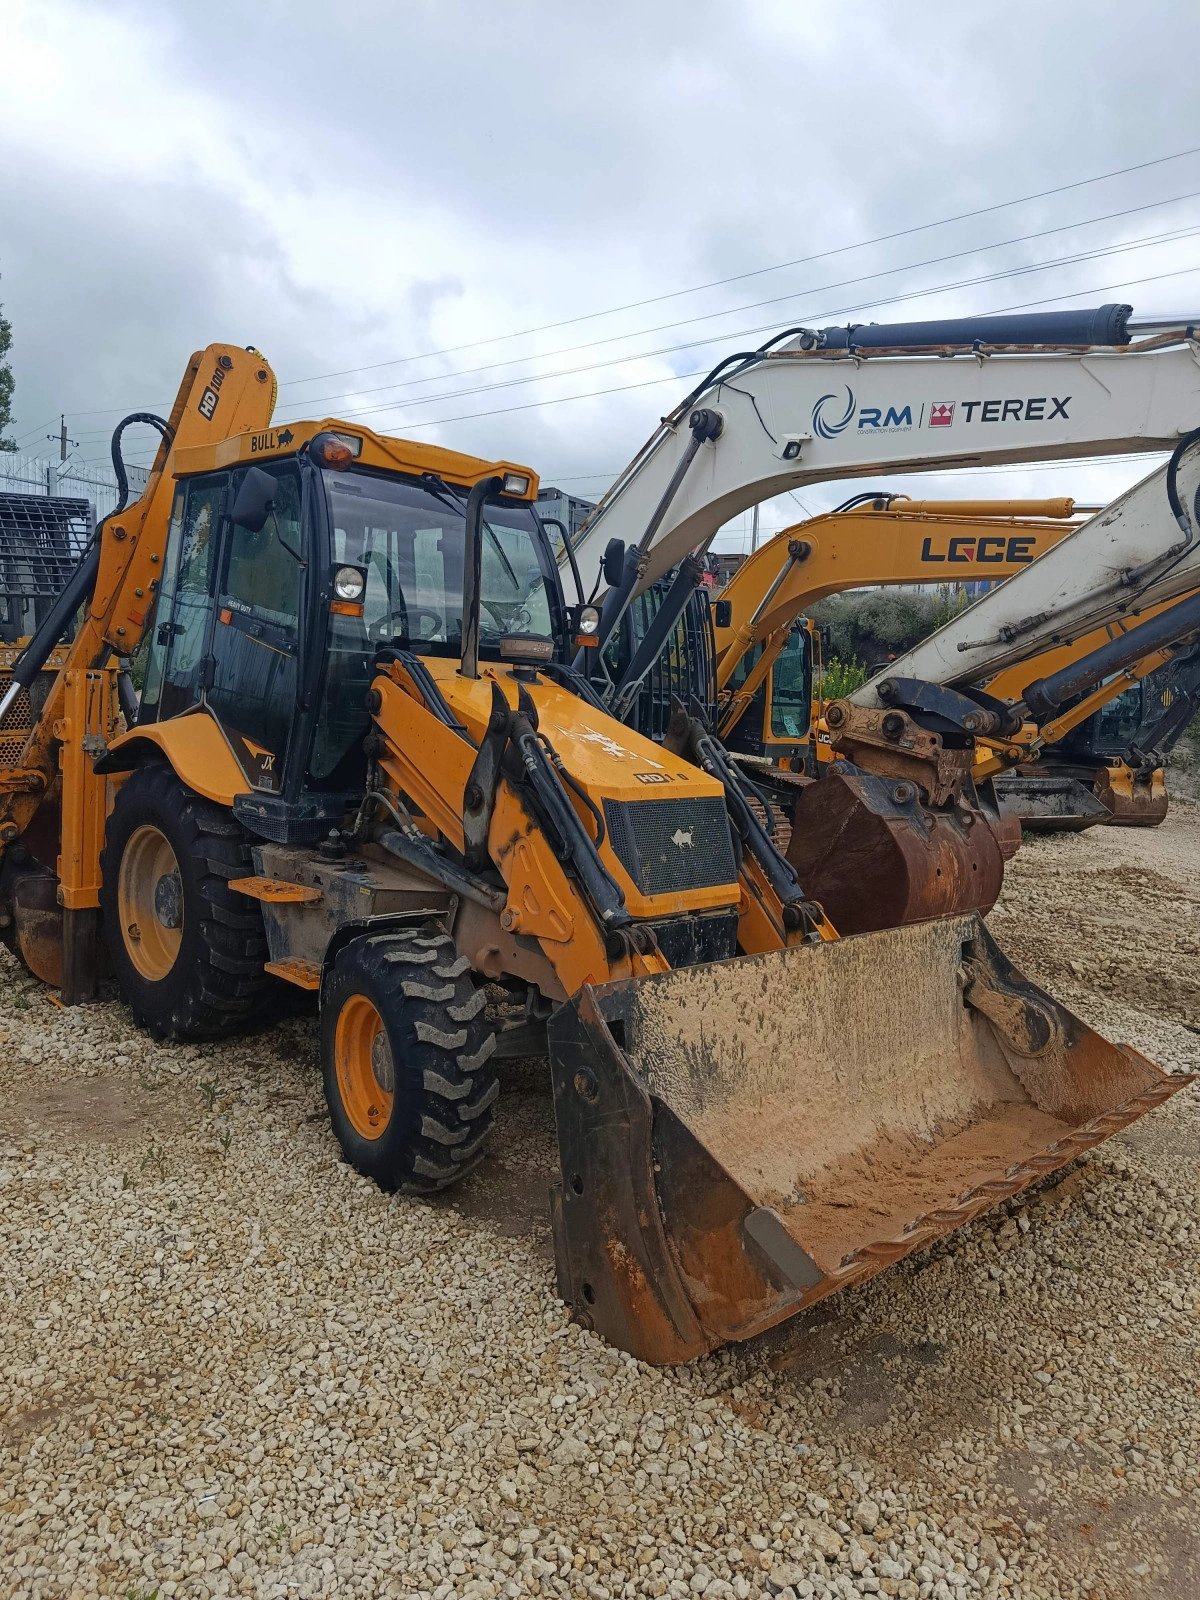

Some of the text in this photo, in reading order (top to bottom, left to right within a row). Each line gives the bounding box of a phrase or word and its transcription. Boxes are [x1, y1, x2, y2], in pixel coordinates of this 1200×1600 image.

[857, 396, 1073, 429] RM TEREX
[251, 433, 275, 452] BULL
[228, 600, 252, 613] HEAVY DUTY
[818, 733, 833, 744] JC
[261, 756, 276, 771] JX
